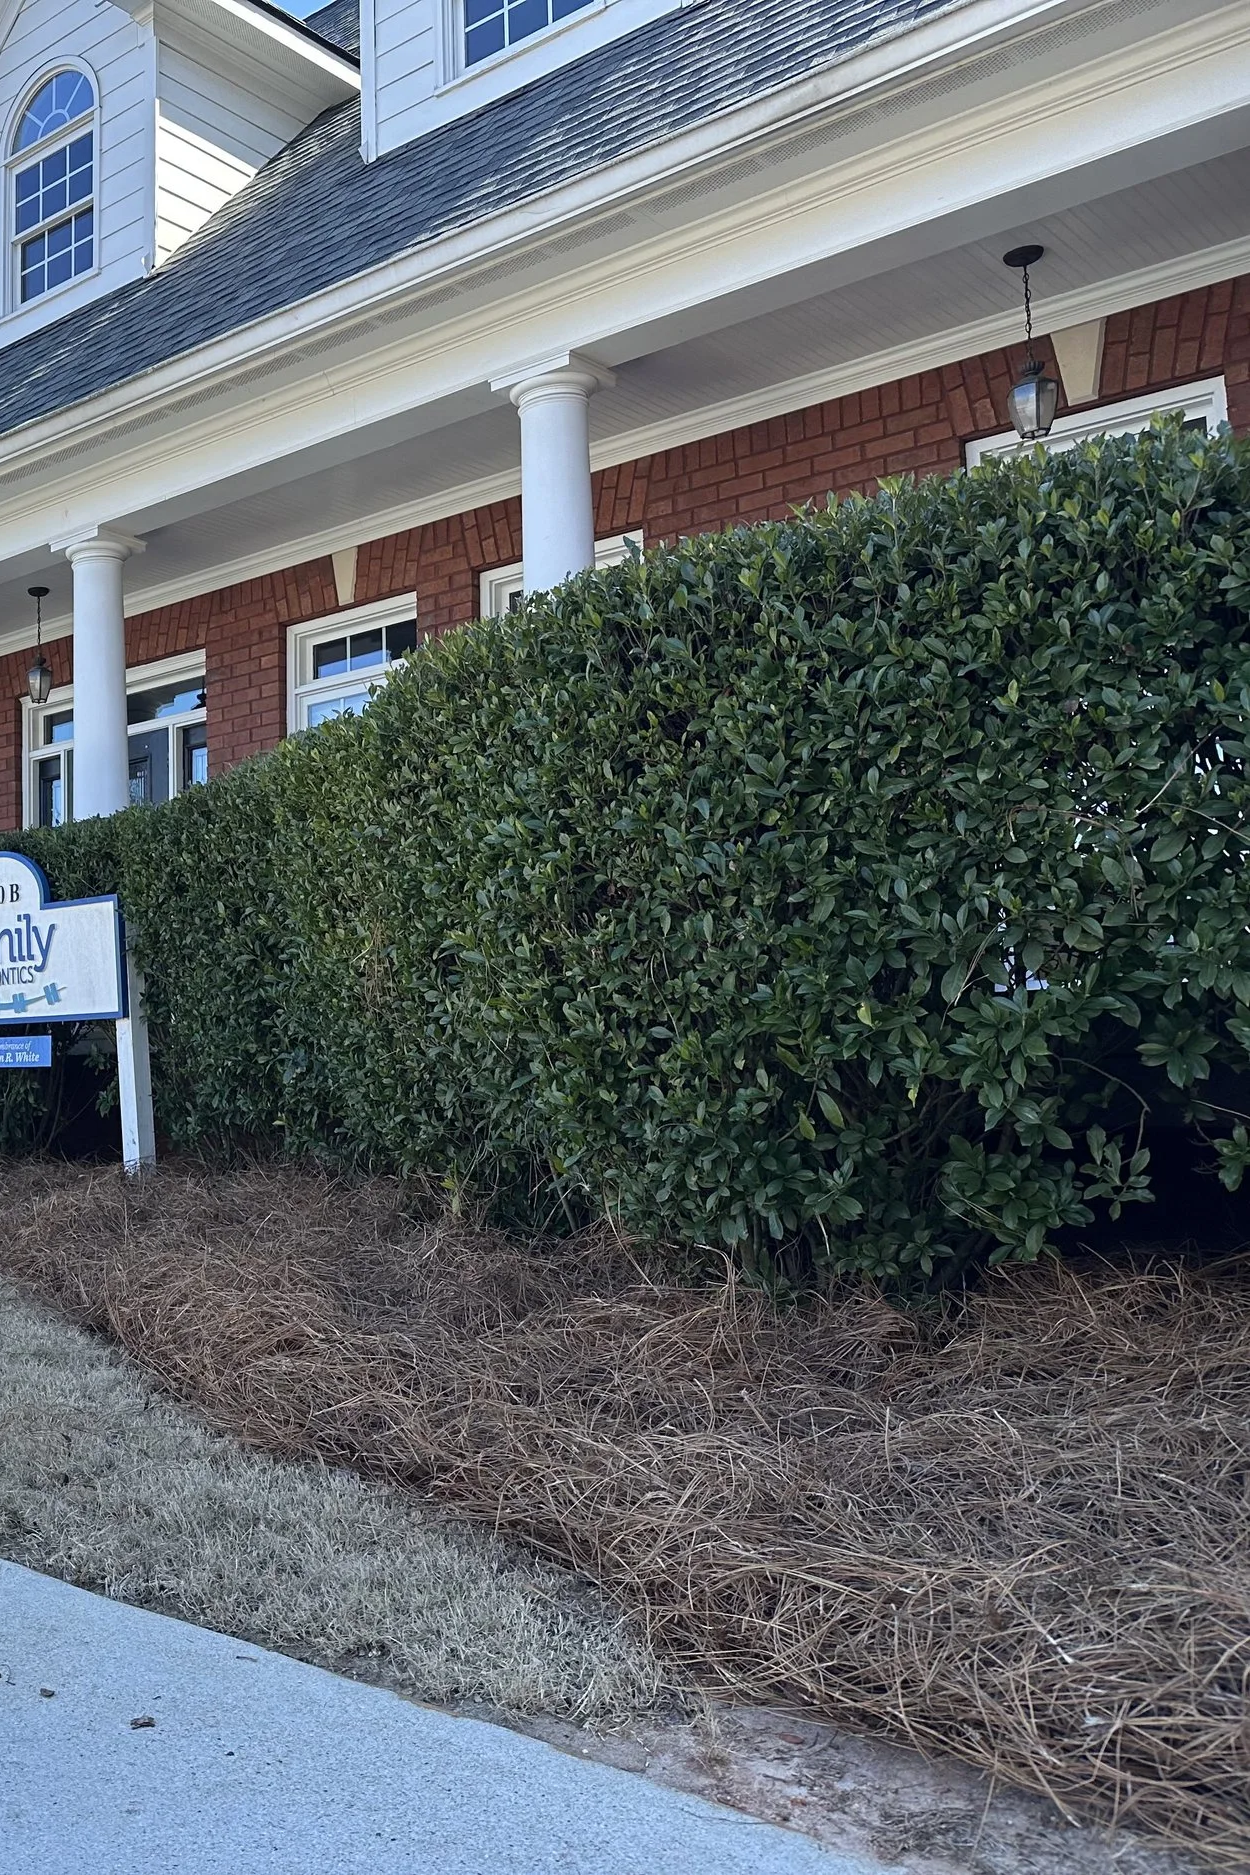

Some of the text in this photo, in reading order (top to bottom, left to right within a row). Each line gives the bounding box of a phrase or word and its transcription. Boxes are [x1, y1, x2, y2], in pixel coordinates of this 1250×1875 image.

[9, 883, 20, 903] B
[24, 1040, 32, 1052] of
[5, 1052, 14, 1063] R.
[15, 1051, 40, 1063] White
